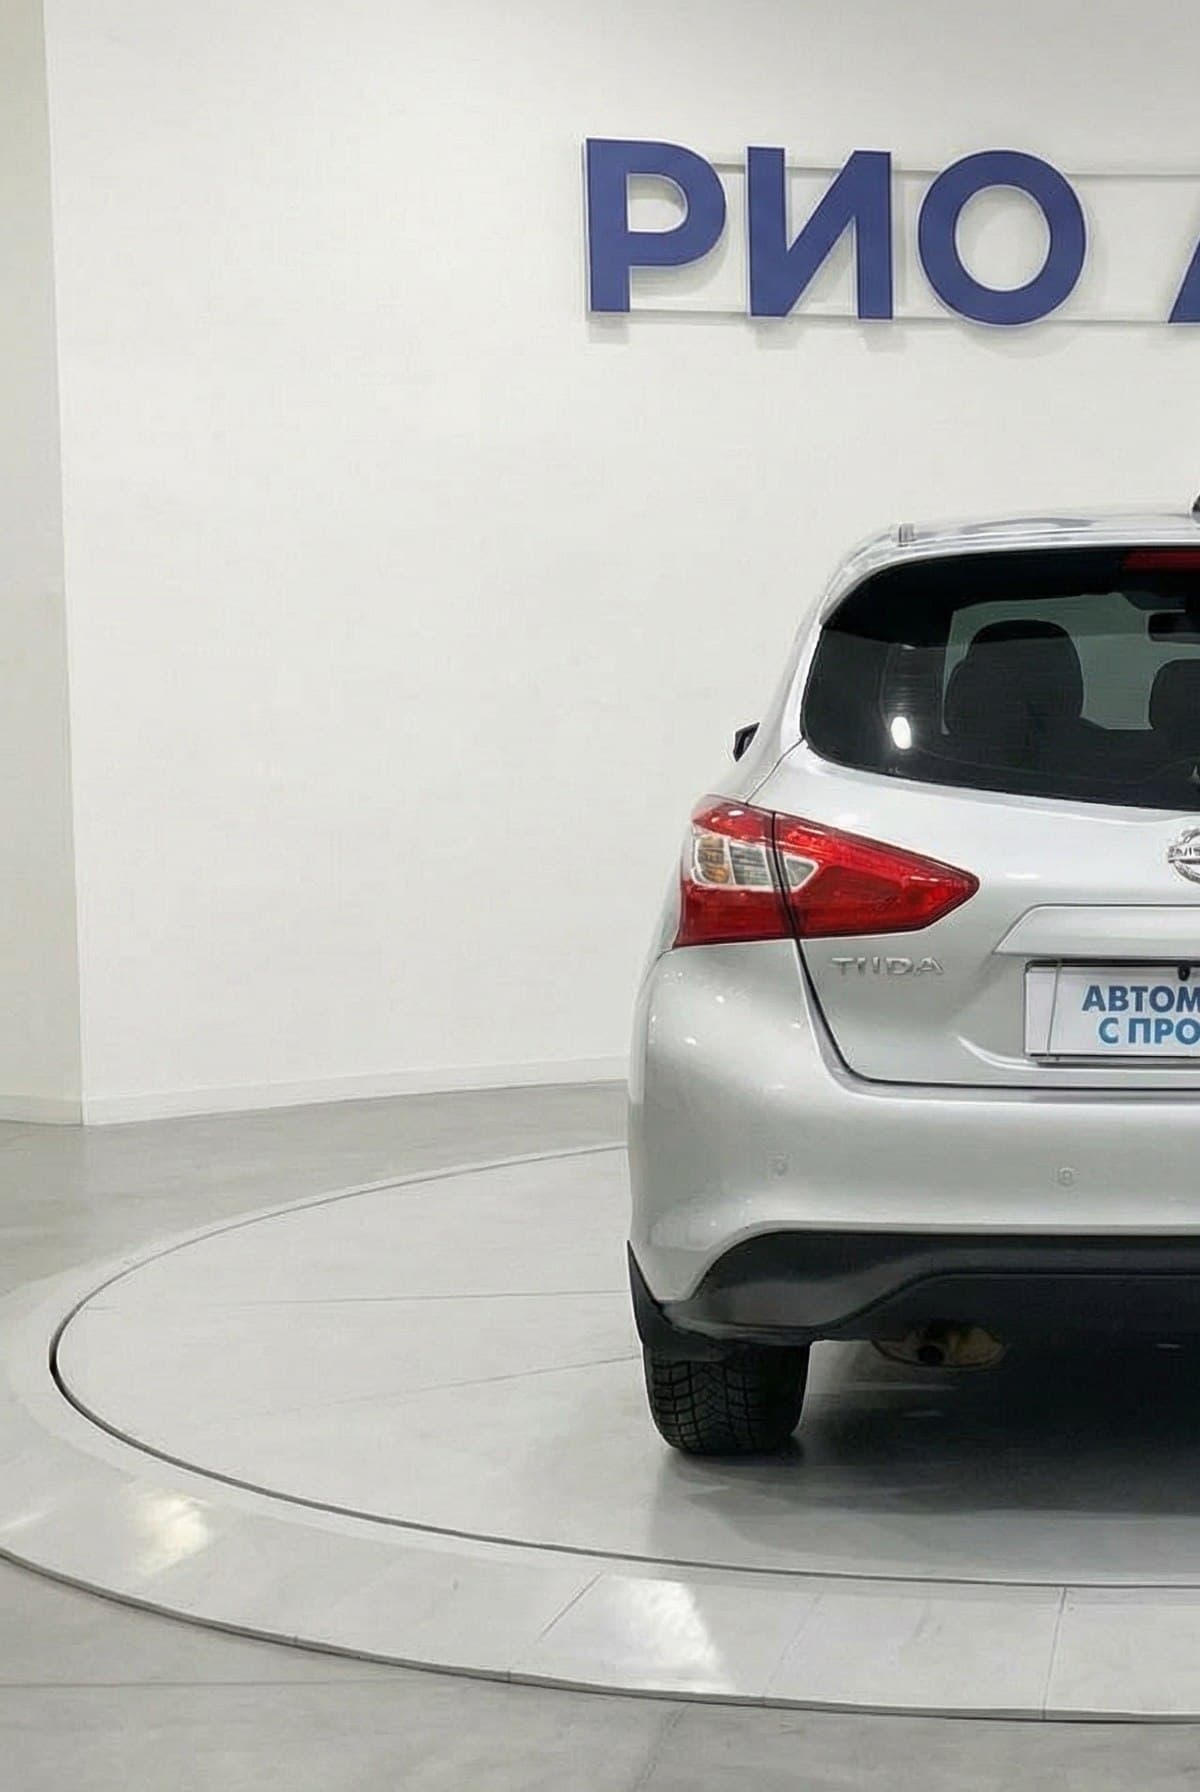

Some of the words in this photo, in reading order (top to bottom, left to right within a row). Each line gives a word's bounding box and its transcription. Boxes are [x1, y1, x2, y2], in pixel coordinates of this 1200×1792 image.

[585, 138, 1087, 325] РИО
[831, 956, 944, 976] TIIDA
[1100, 1017, 1119, 1044] С
